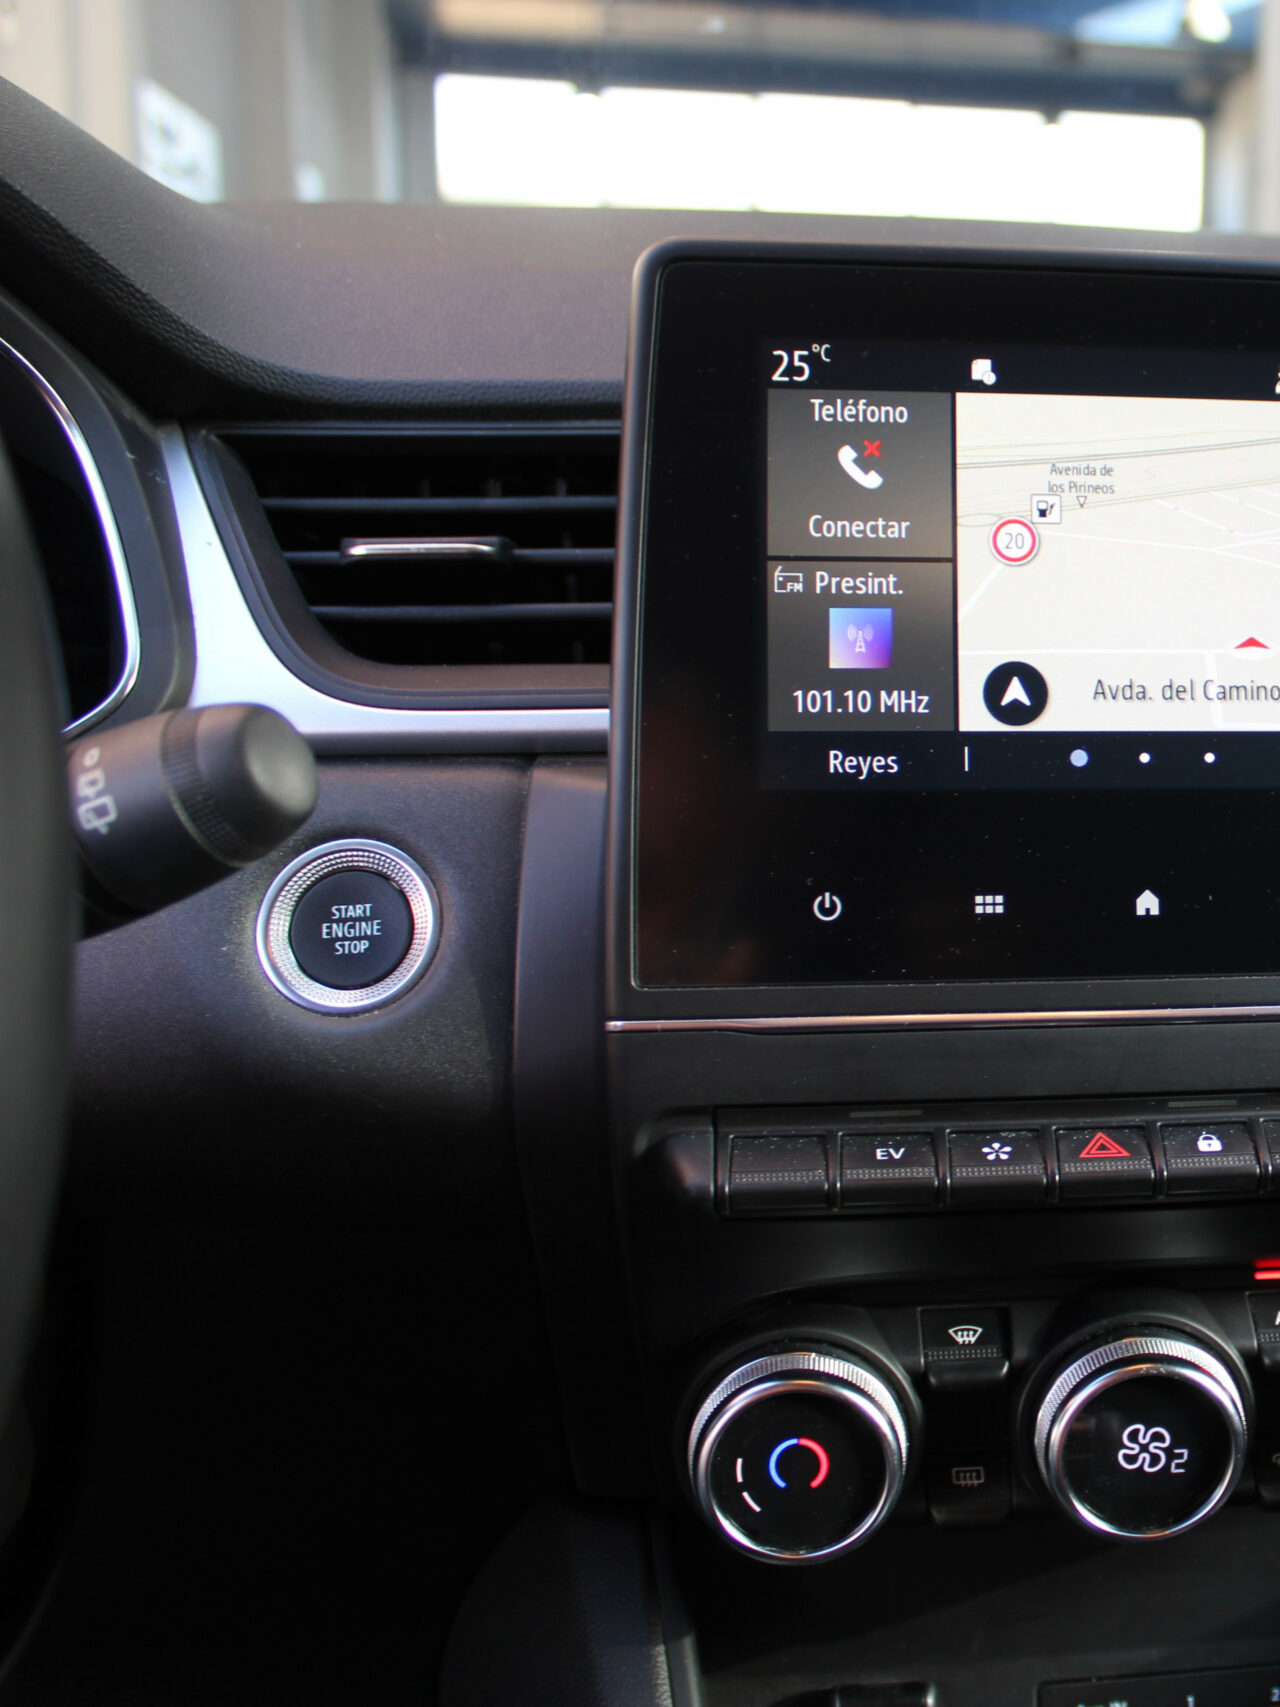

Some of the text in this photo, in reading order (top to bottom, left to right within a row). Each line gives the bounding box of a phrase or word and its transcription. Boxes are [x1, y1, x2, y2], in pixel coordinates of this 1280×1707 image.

[809, 398, 909, 424] Teléfono
[1049, 462, 1114, 477] Avenida de
[1048, 480, 1116, 495] los Pirineos
[808, 514, 911, 539] Conectar
[1004, 531, 1025, 550] 20
[786, 582, 804, 593] FM
[815, 571, 904, 595] Presint.
[1092, 678, 1153, 701] Avda.
[1161, 678, 1195, 701] del
[1202, 679, 1280, 701] Camino
[792, 690, 930, 713] 101.10 MHz
[828, 750, 899, 780] Reyes
[331, 904, 373, 919] START
[321, 920, 383, 939] ENGINE
[334, 940, 370, 955] STOP
[875, 1147, 906, 1160] EV
[1170, 1448, 1189, 1474] 2
